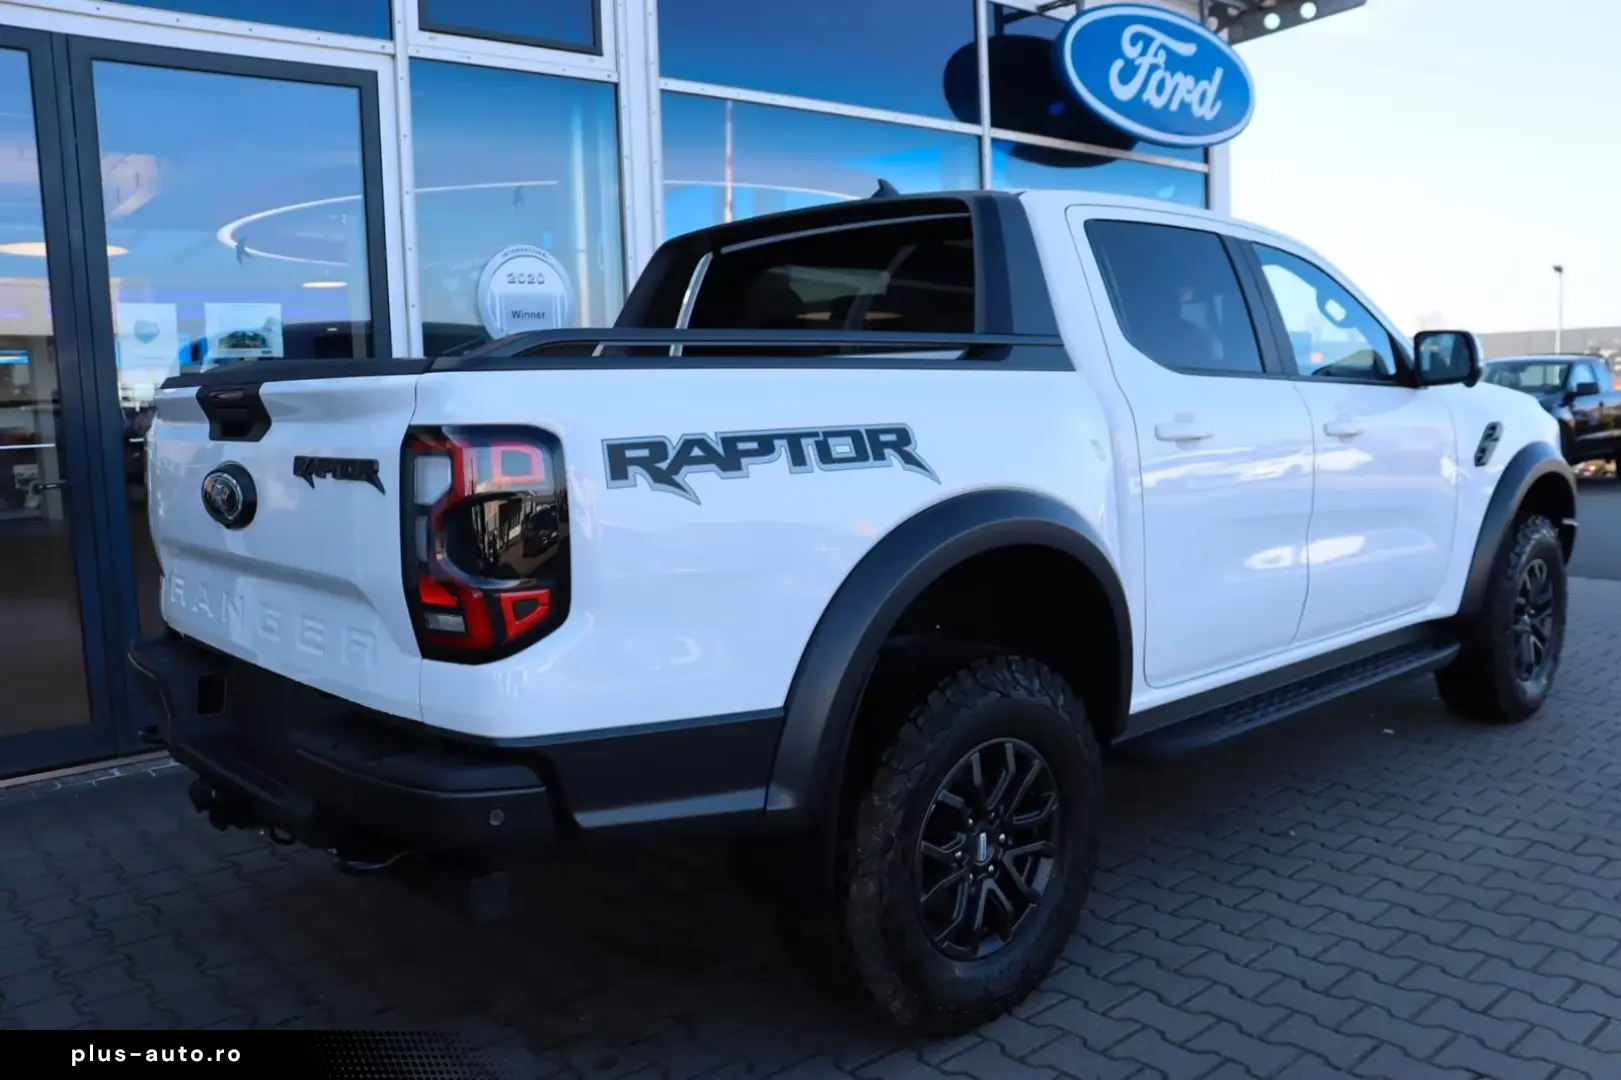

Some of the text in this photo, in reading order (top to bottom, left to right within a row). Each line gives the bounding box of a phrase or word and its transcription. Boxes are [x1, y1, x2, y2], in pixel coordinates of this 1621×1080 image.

[1108, 23, 1224, 121] Ford
[507, 271, 545, 284] 2020
[511, 309, 546, 320] Winner
[293, 455, 386, 496] RAPTOR
[601, 422, 942, 505] RAPTOR
[170, 573, 377, 670] RANGER
